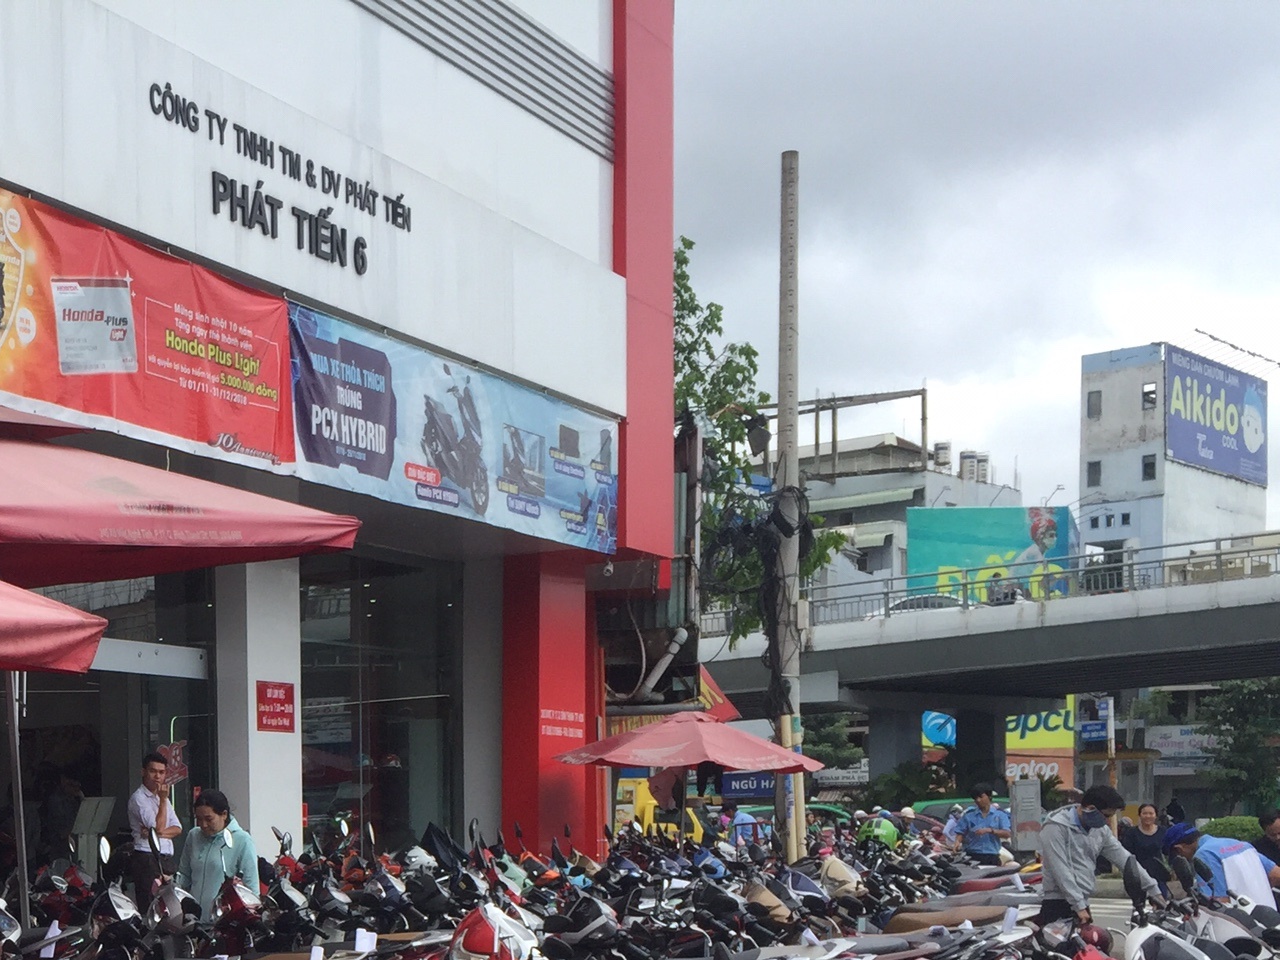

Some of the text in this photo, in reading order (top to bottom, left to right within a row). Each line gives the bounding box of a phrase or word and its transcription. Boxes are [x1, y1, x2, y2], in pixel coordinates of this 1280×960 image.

[149, 82, 412, 232] CÔNG TY TNHH TM & DV PHÁT TIẾN
[211, 170, 368, 276] PHÁT TIẾN 6
[62, 308, 105, 322] Honda
[229, 321, 238, 333] 10
[165, 329, 261, 378] Honda Plus Light
[330, 357, 341, 379] XE
[336, 384, 363, 411] TRÚNG
[1170, 374, 1239, 435] Aikido
[311, 403, 387, 455] PCX HYBRID
[1221, 434, 1239, 451] COOL
[731, 777, 757, 790] NGŨ
